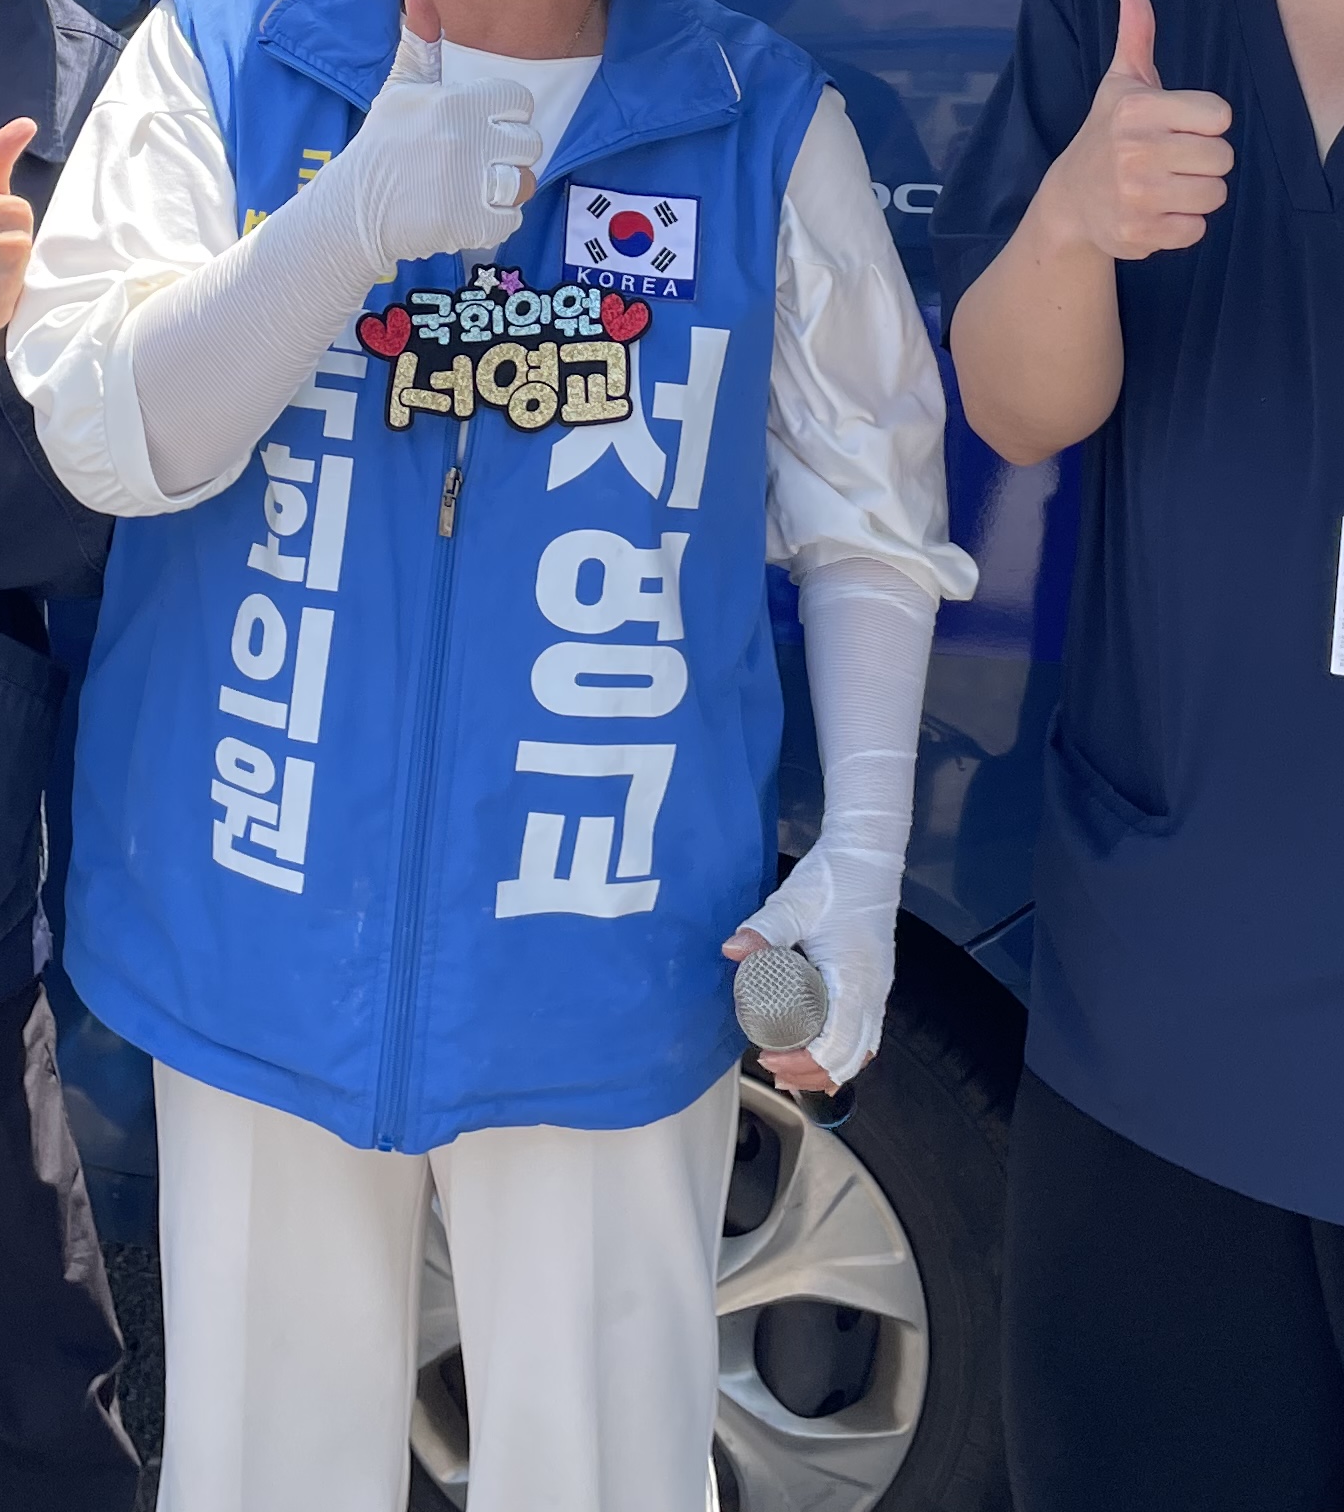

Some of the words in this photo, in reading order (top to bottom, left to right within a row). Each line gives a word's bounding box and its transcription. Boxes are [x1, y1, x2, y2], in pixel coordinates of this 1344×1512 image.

[411, 285, 604, 346] 국회의원
[576, 266, 681, 299] KOREA
[388, 341, 631, 429] 서영교
[494, 326, 731, 920] 서영교
